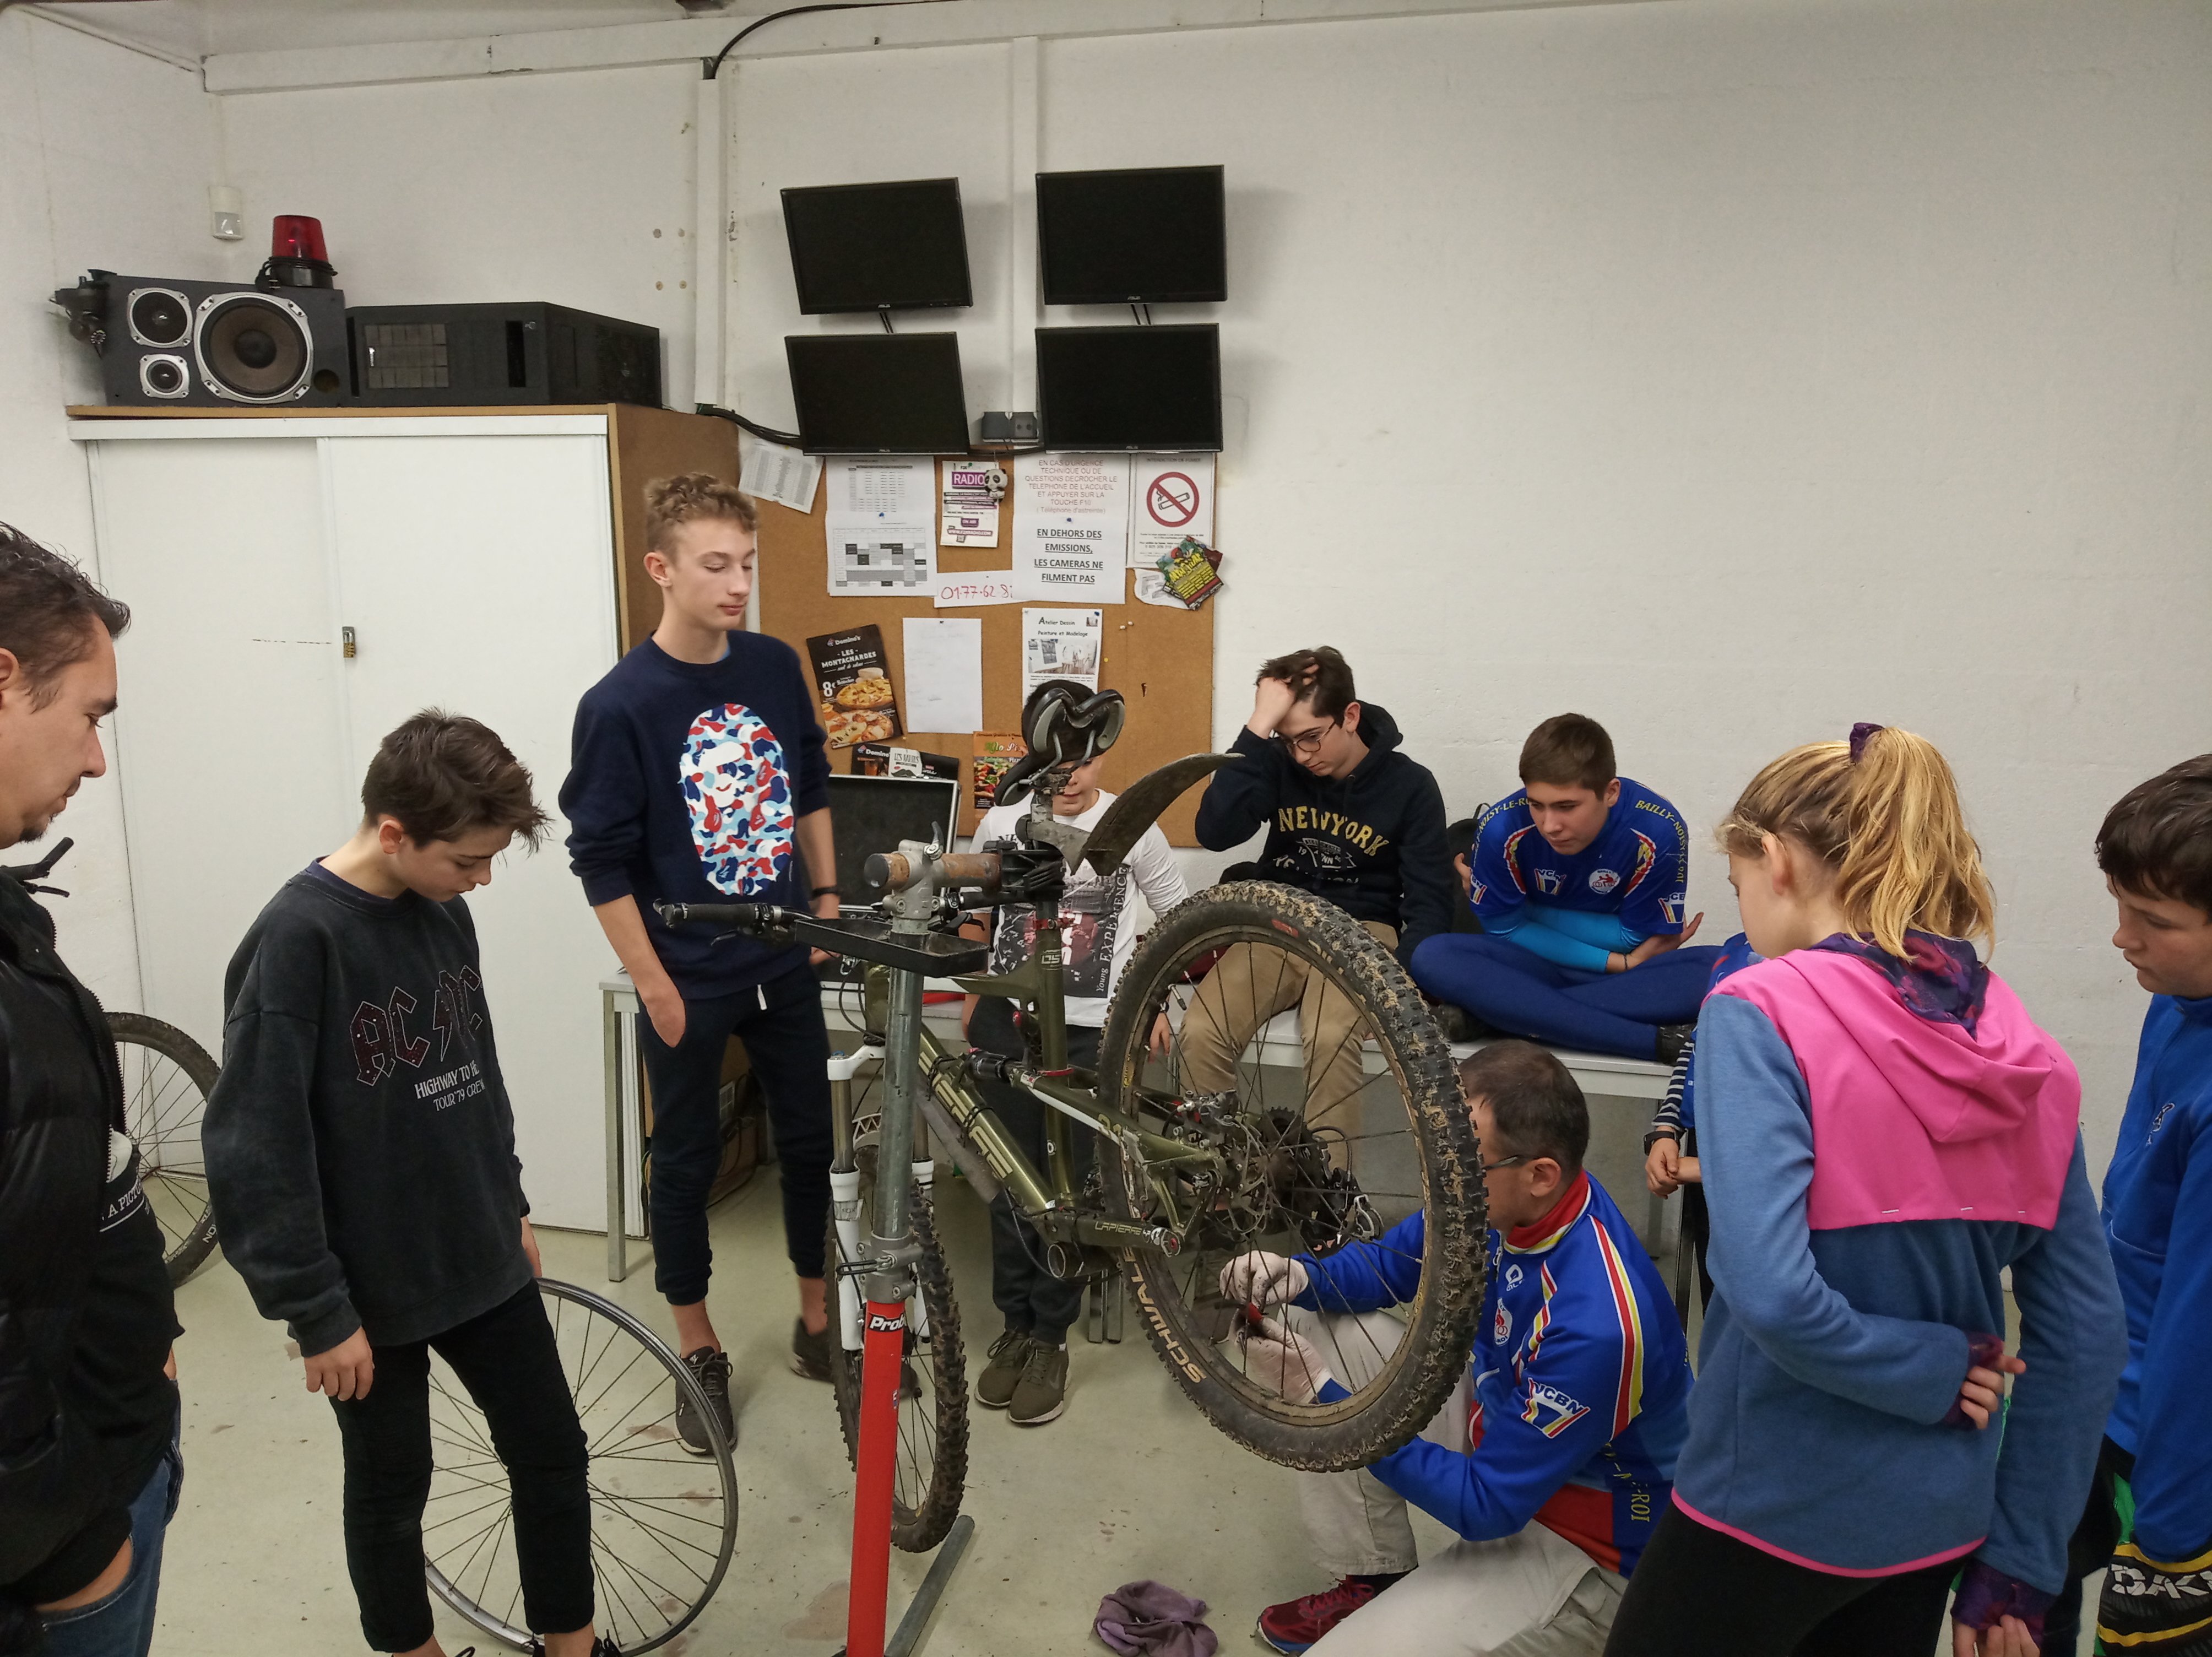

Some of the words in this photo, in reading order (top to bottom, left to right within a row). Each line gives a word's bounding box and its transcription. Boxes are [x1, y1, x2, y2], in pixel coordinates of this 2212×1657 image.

[953, 474, 985, 485] RADIO
[1050, 529, 1084, 538] DEHORS
[1086, 530, 1102, 538] DES
[1045, 543, 1093, 554] EMISSIONS,
[1050, 559, 1090, 568] CAMERAS
[1042, 573, 1078, 582] FILMENT
[1080, 575, 1095, 583] PAS
[1038, 616, 1058, 625] Atelier
[835, 635, 861, 646] Domino's
[1096, 967, 1109, 993] Young
[414, 1070, 458, 1100] HIGHWAY
[460, 1064, 470, 1082] TO
[471, 1060, 480, 1078] HE
[433, 1092, 456, 1112] TOUR
[108, 1204, 118, 1219] A
[118, 1182, 142, 1211] PICTU
[1095, 1221, 1142, 1236] LAPIERRE
[1534, 1383, 1585, 1415] VCBN
